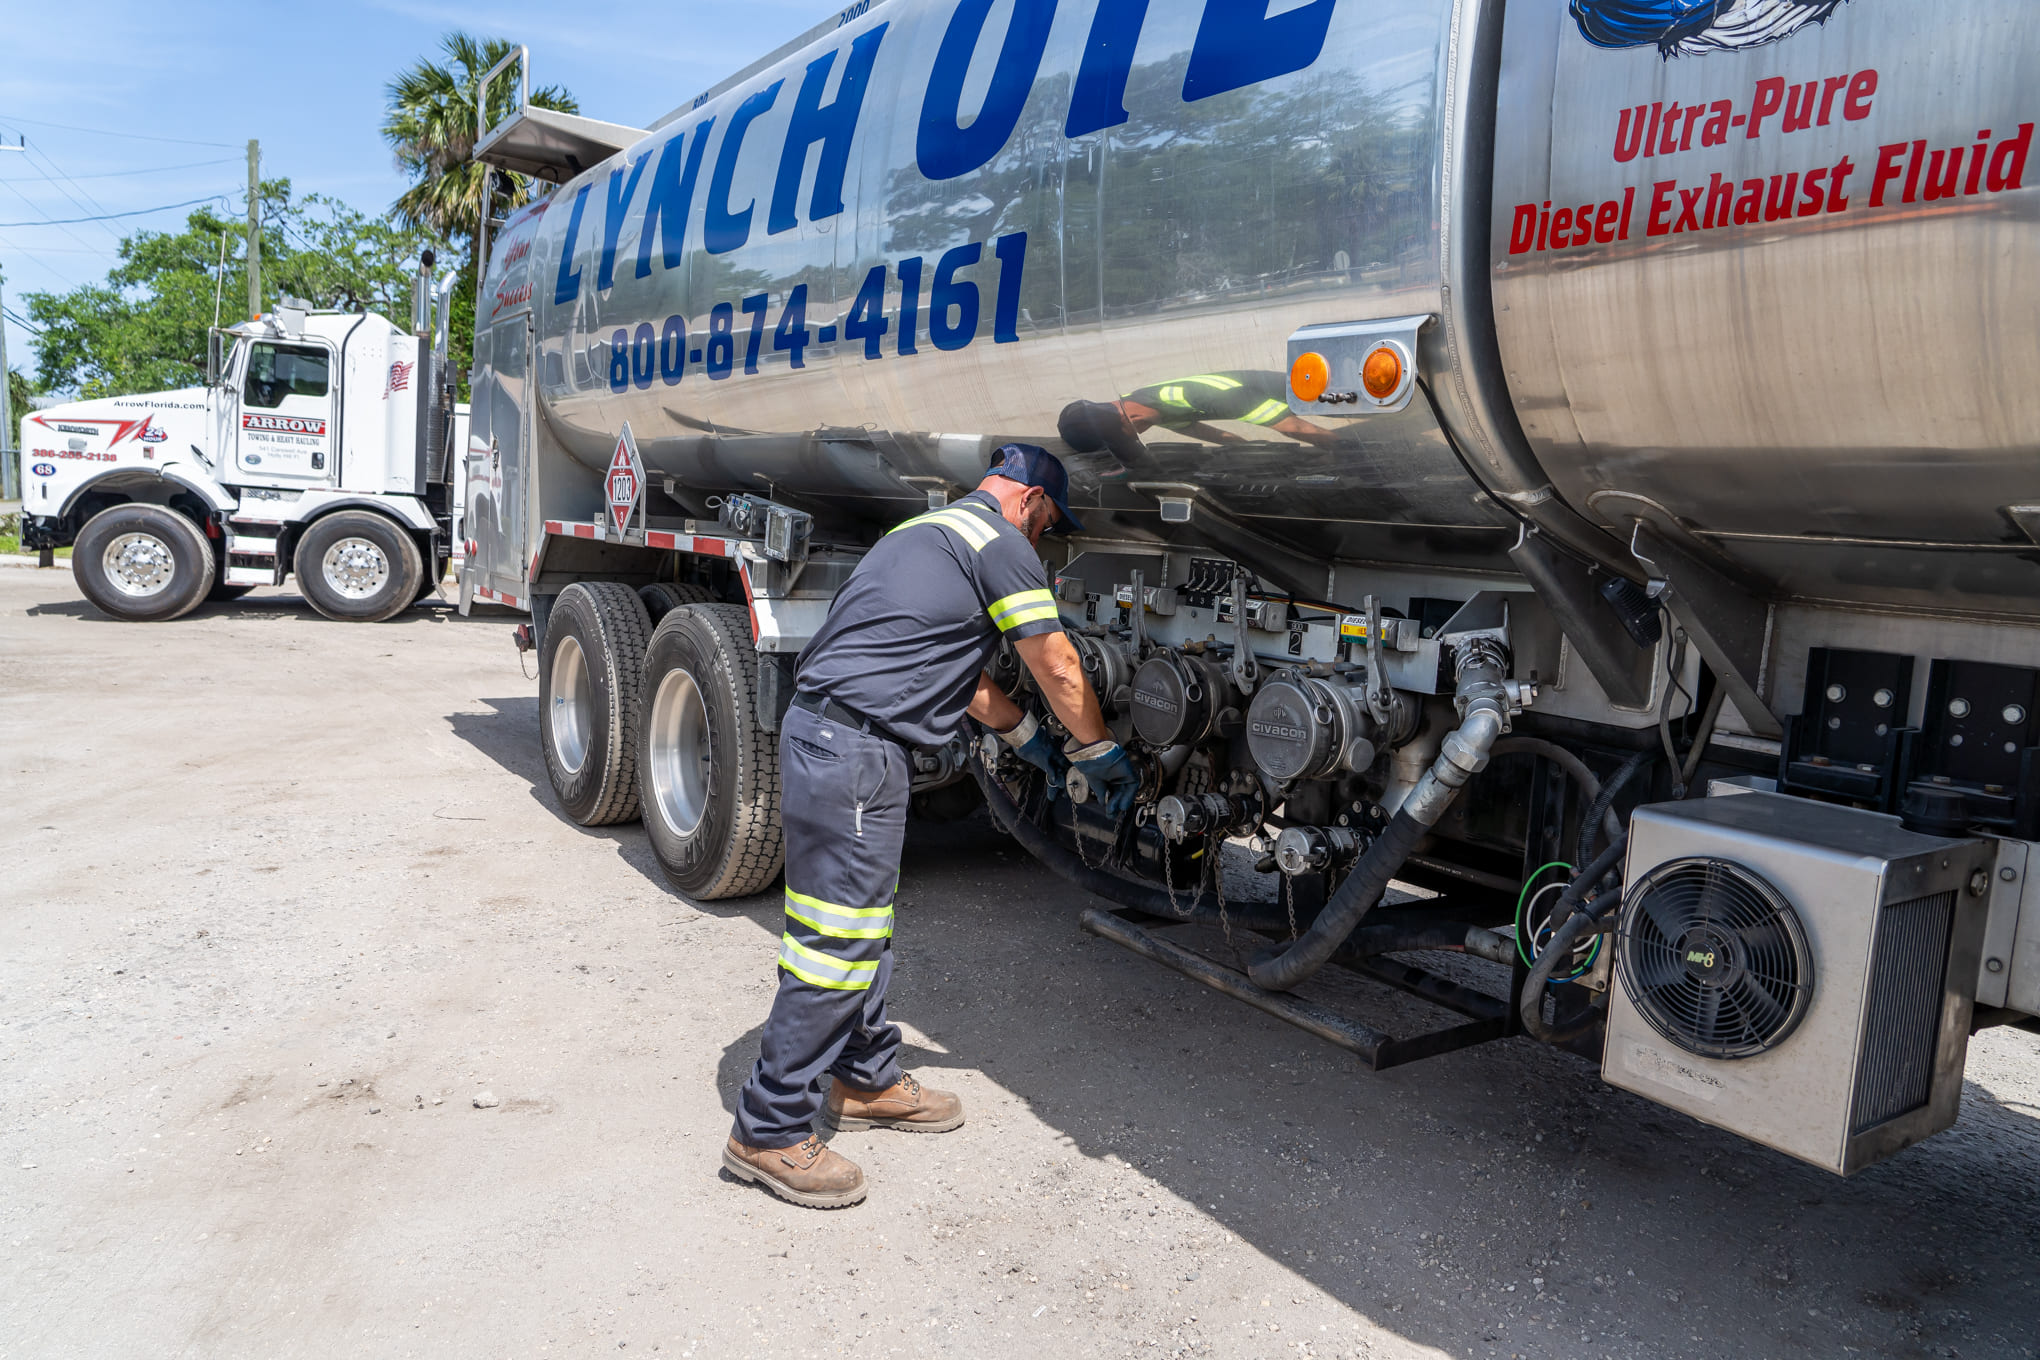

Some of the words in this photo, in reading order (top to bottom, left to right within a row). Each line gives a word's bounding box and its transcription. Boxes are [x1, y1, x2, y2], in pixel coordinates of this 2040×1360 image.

[1613, 68, 1879, 164] Ultra-Pure
[554, 20, 890, 305] LYNCH
[1509, 187, 1635, 255] Diesel
[1646, 155, 1856, 237] Exhaust
[1868, 122, 2036, 208] Fluid
[492, 279, 533, 317] Success
[609, 231, 1028, 395] 800-874-4161
[113, 400, 205, 410] ArrowFlorida.com
[246, 416, 322, 432] ARROW
[247, 432, 270, 442] TOWING
[271, 434, 276, 443] &
[276, 435, 294, 445] HEAVY
[295, 437, 320, 447] HAULING
[31, 448, 118, 462] 386-255-2138
[36, 464, 53, 475] 68
[613, 477, 632, 502] 1203
[619, 511, 625, 524] 3
[1289, 632, 1302, 655] 2
